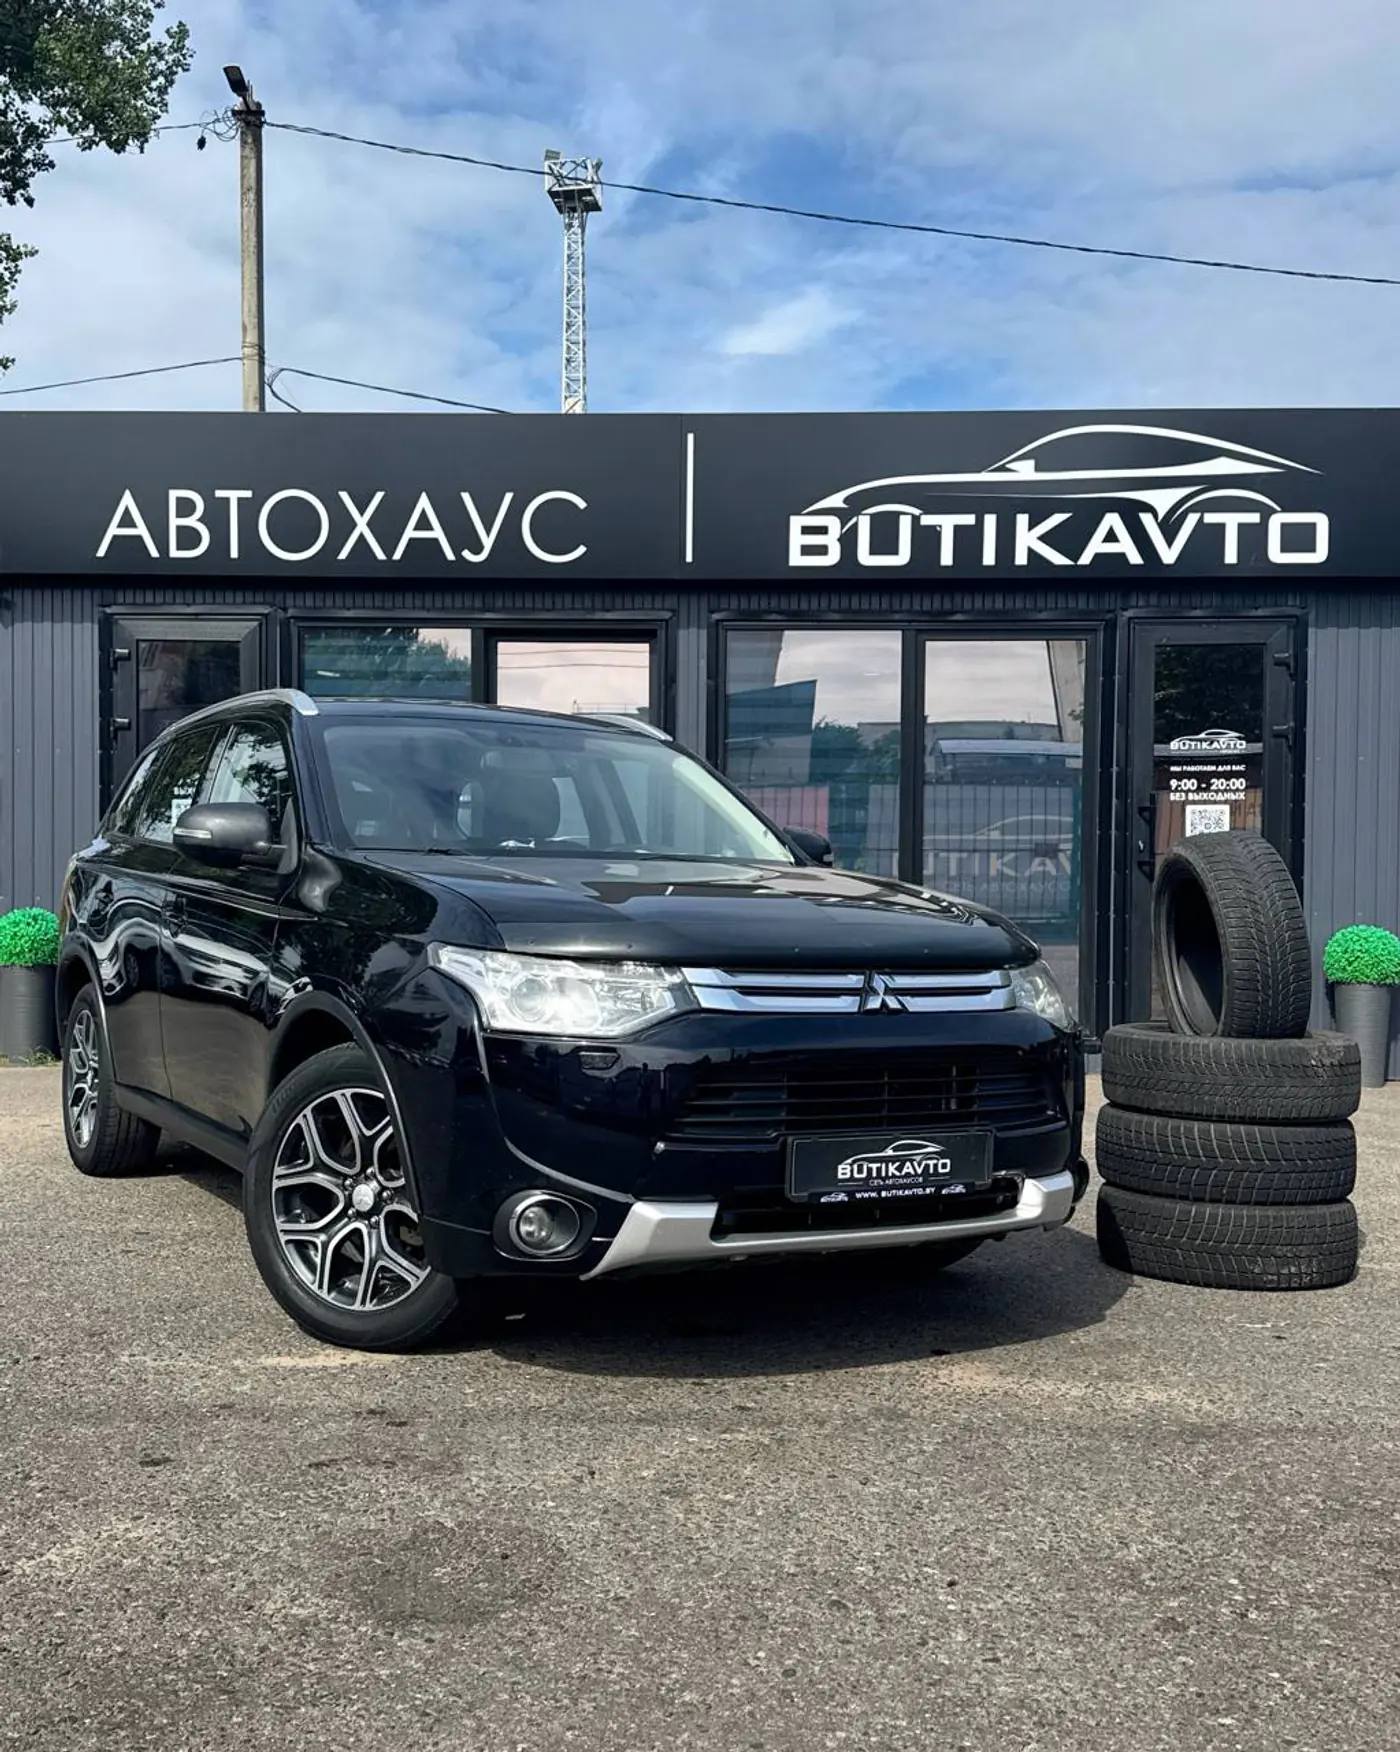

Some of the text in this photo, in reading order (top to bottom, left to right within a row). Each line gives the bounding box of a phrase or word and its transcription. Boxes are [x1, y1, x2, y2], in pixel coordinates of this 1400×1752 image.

[96, 488, 588, 563] АВТОХАУС
[788, 512, 1330, 567] BUTIKAVTO
[1170, 740, 1246, 750] BUTIKAVTO
[1170, 779, 1197, 790] 9:00
[1210, 778, 1246, 790] 20:00
[1188, 792, 1245, 800] ВЫХОДНЫХ
[837, 1159, 951, 1178] BUTIKAVTO
[881, 1187, 936, 1198] BUTIKAVTO.BY
